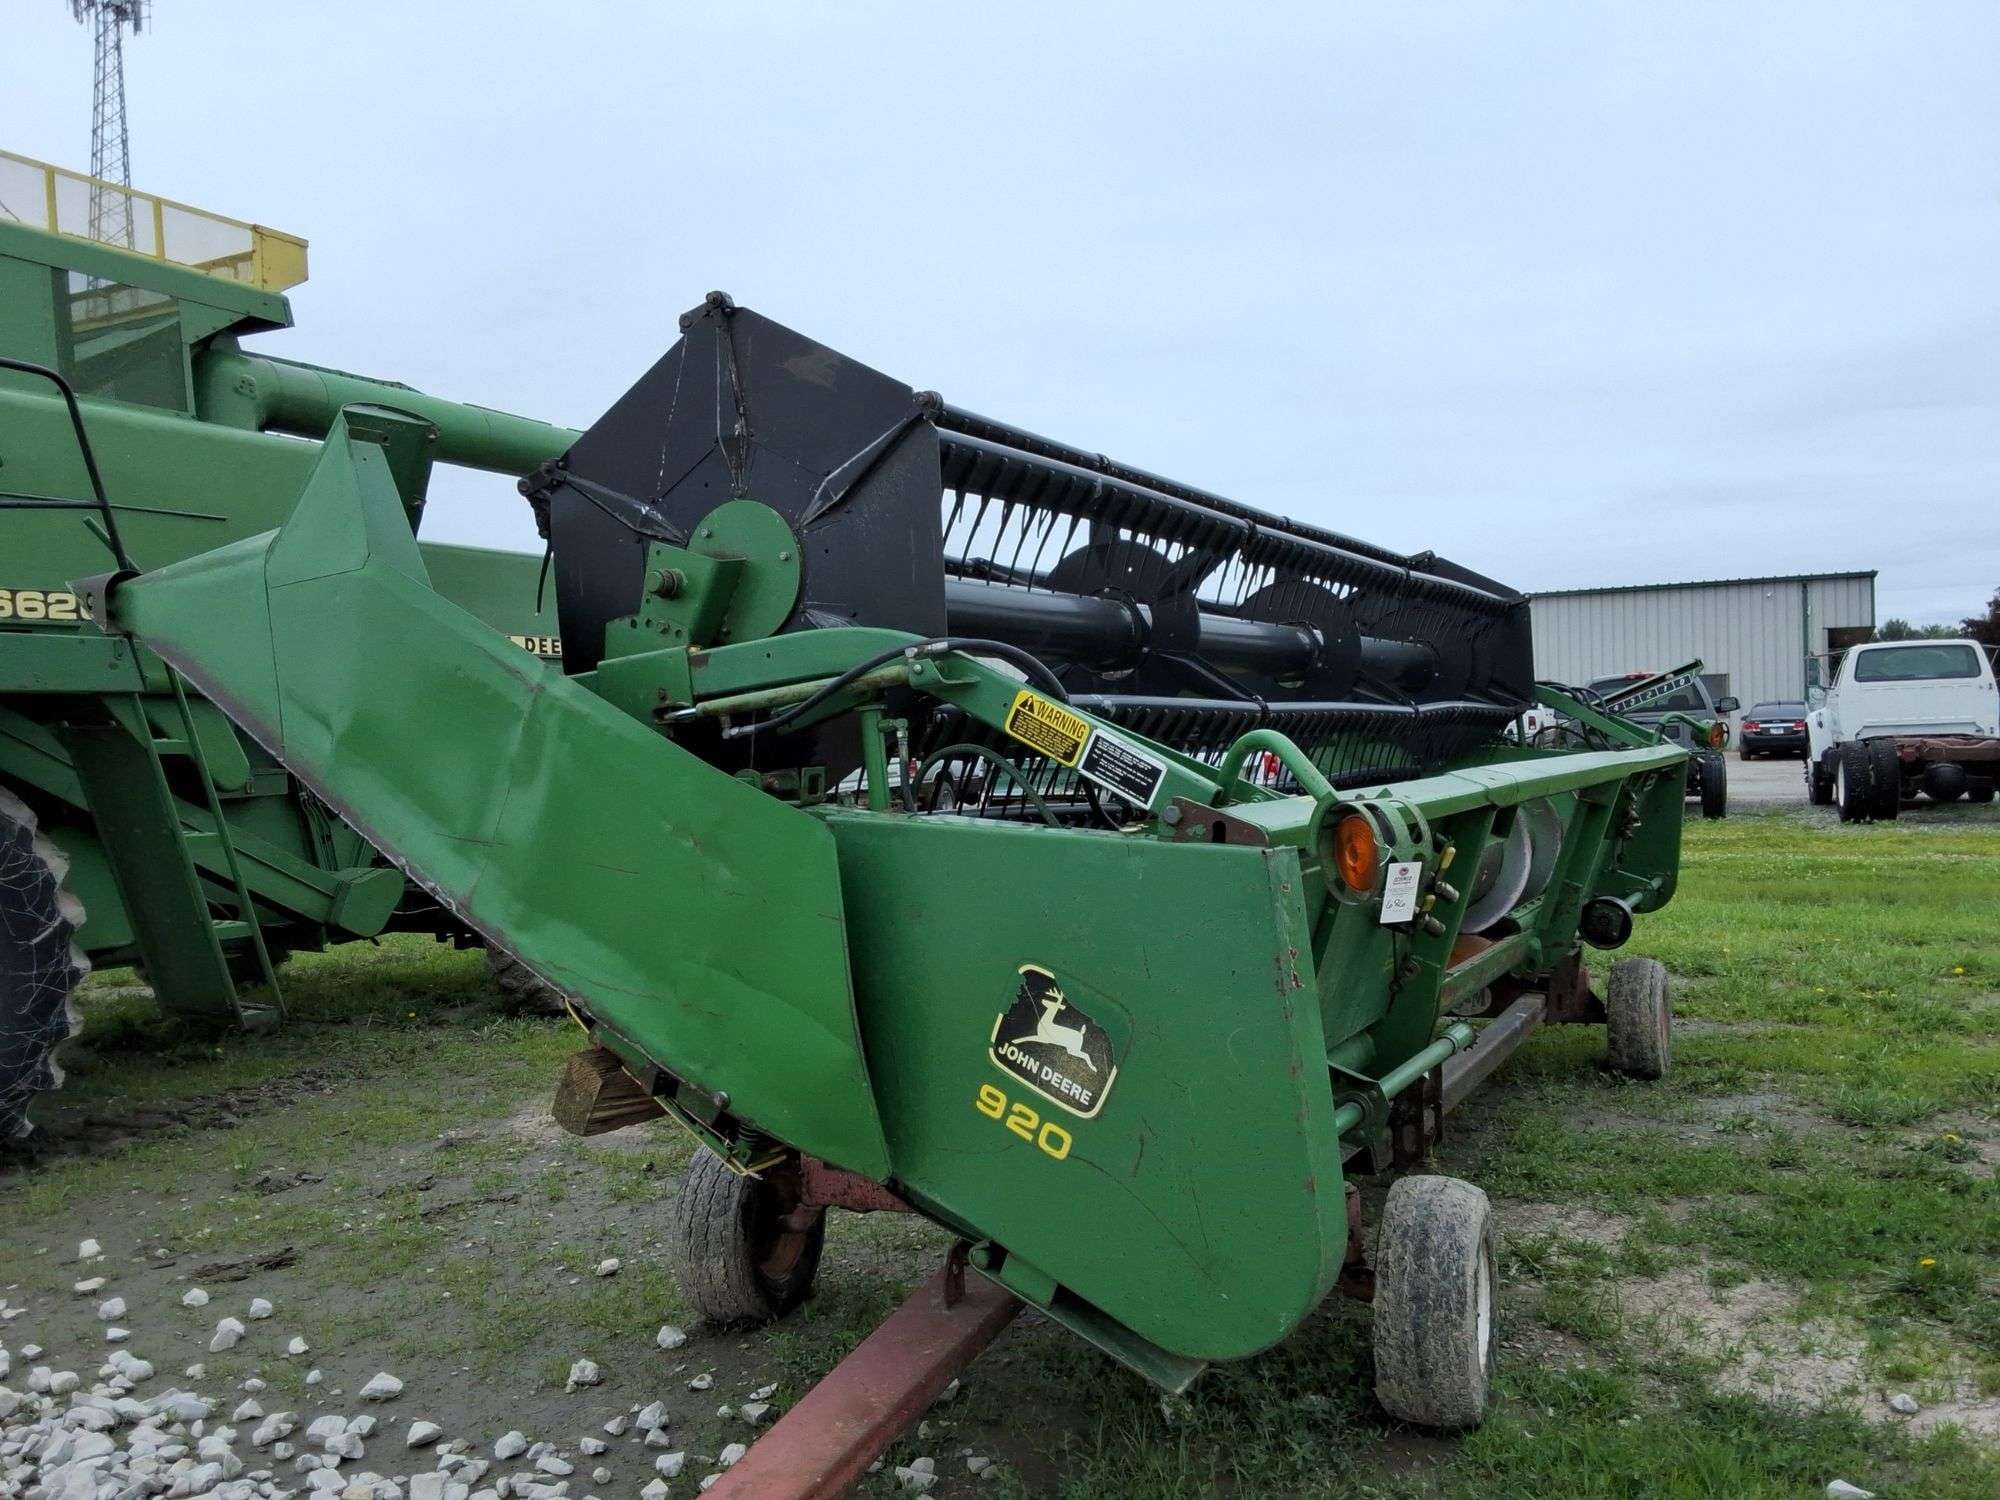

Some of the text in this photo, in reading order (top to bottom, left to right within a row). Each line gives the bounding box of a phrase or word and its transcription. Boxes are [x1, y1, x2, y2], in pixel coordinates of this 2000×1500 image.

[525, 637, 561, 654] DEE
[1036, 700, 1086, 740] WARNING
[998, 1042, 1092, 1106] JOHN DEERE
[976, 1083, 1072, 1160] 920
